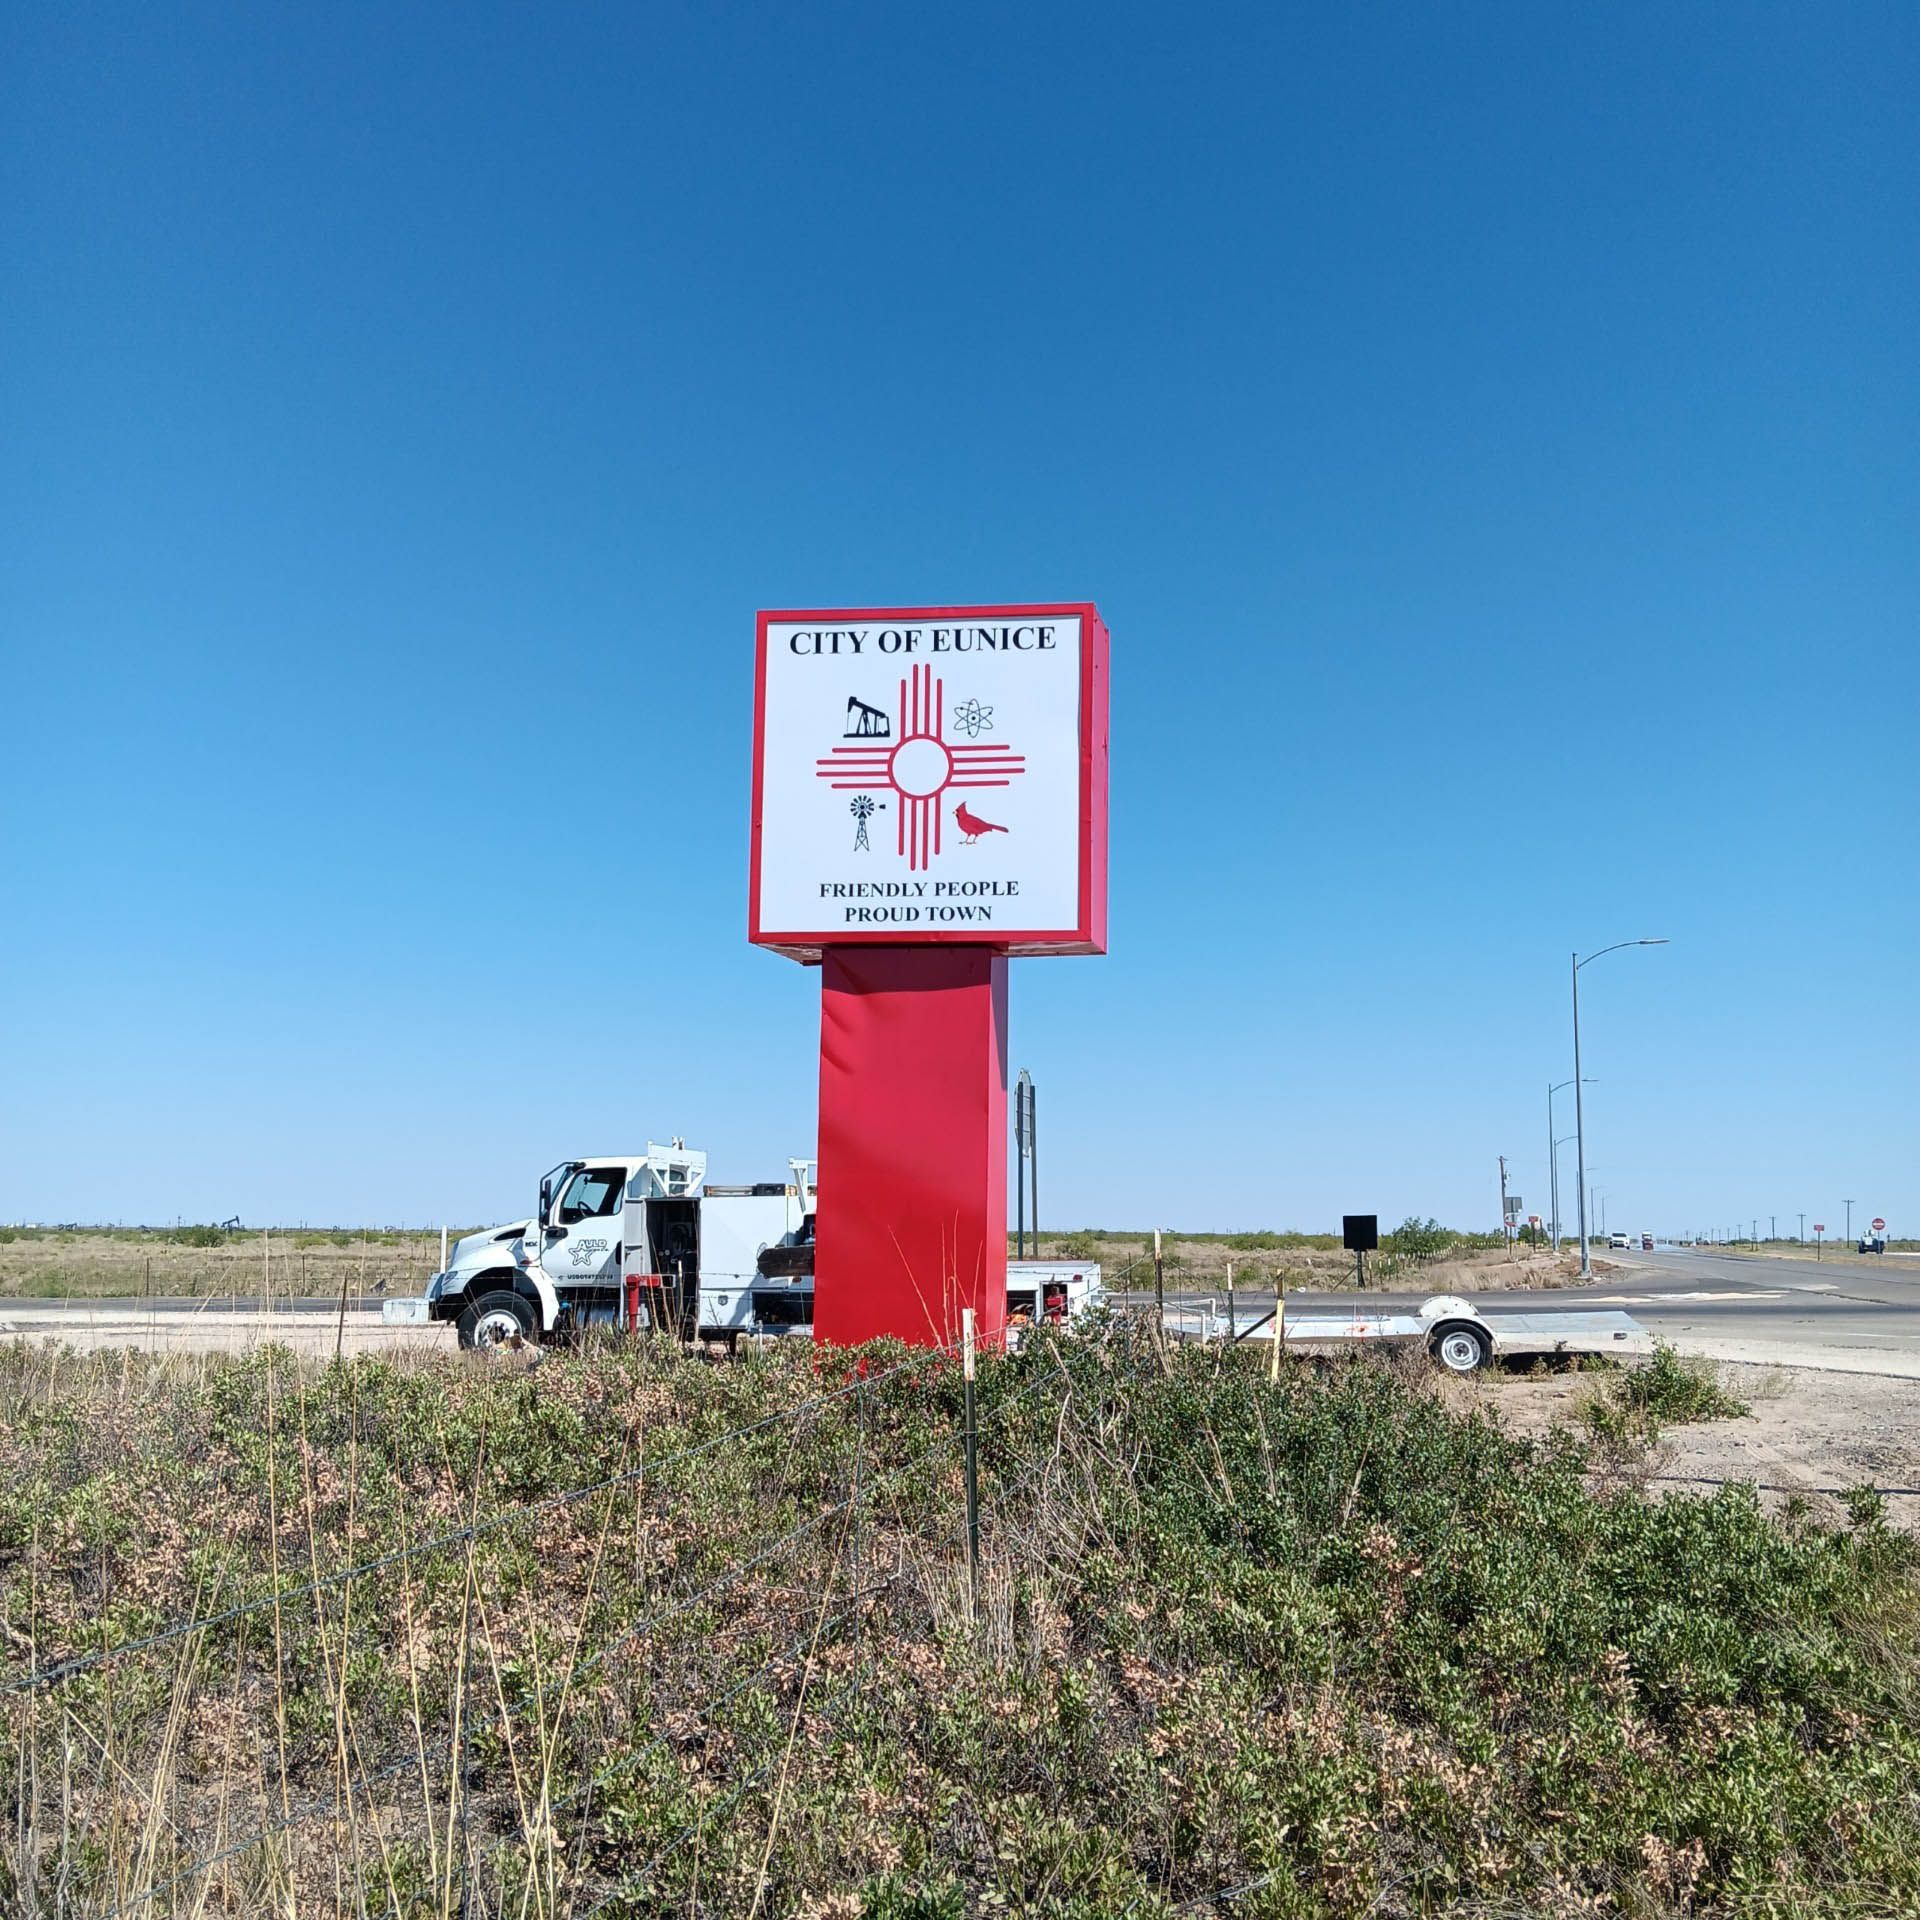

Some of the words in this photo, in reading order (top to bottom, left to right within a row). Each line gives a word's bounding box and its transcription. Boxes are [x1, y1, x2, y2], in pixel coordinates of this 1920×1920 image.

[789, 631, 869, 655] CITY
[878, 630, 922, 654] OF
[931, 626, 1056, 652] EUNICE
[819, 882, 927, 898] FRIENDLY
[934, 881, 1019, 897] PEOPLE
[845, 906, 920, 923] PROUD
[925, 905, 993, 921] TOWN
[577, 1239, 607, 1249] AULD
